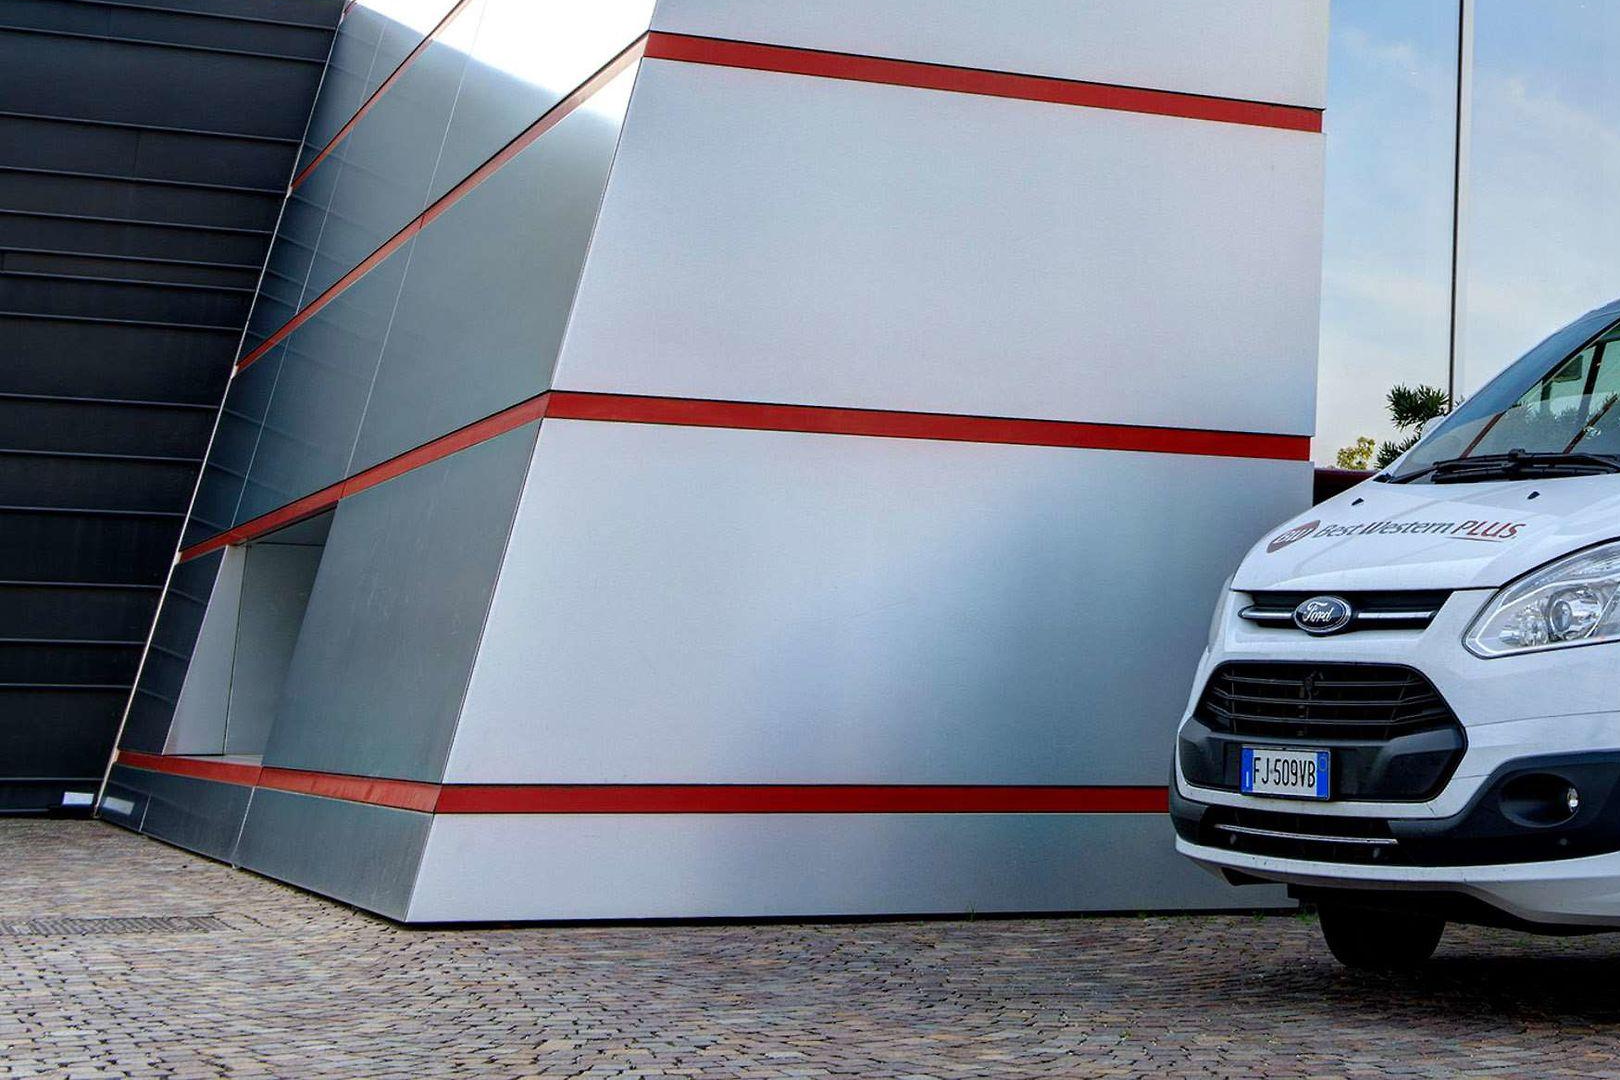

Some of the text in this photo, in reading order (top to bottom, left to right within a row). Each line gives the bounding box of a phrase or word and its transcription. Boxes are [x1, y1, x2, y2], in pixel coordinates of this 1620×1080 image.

[1312, 523, 1363, 538] Best
[1358, 520, 1456, 535] Western
[1302, 600, 1334, 623] Ford
